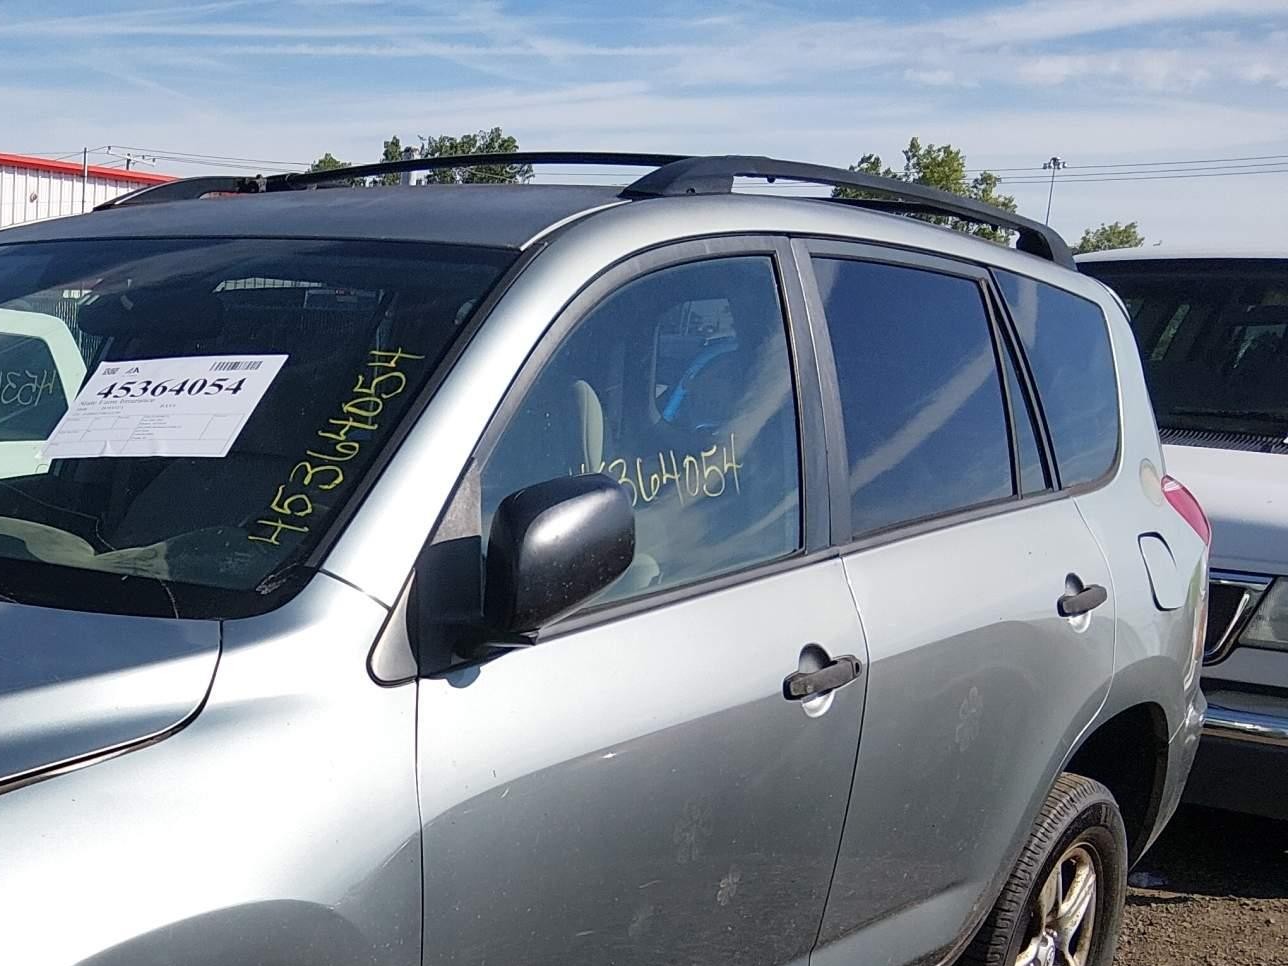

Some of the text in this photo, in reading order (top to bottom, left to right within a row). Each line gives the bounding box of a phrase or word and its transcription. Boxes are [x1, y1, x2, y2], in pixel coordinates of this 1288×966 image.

[96, 377, 247, 399] 45364054
[248, 347, 425, 544] 45364054
[569, 432, 743, 507] 364054
